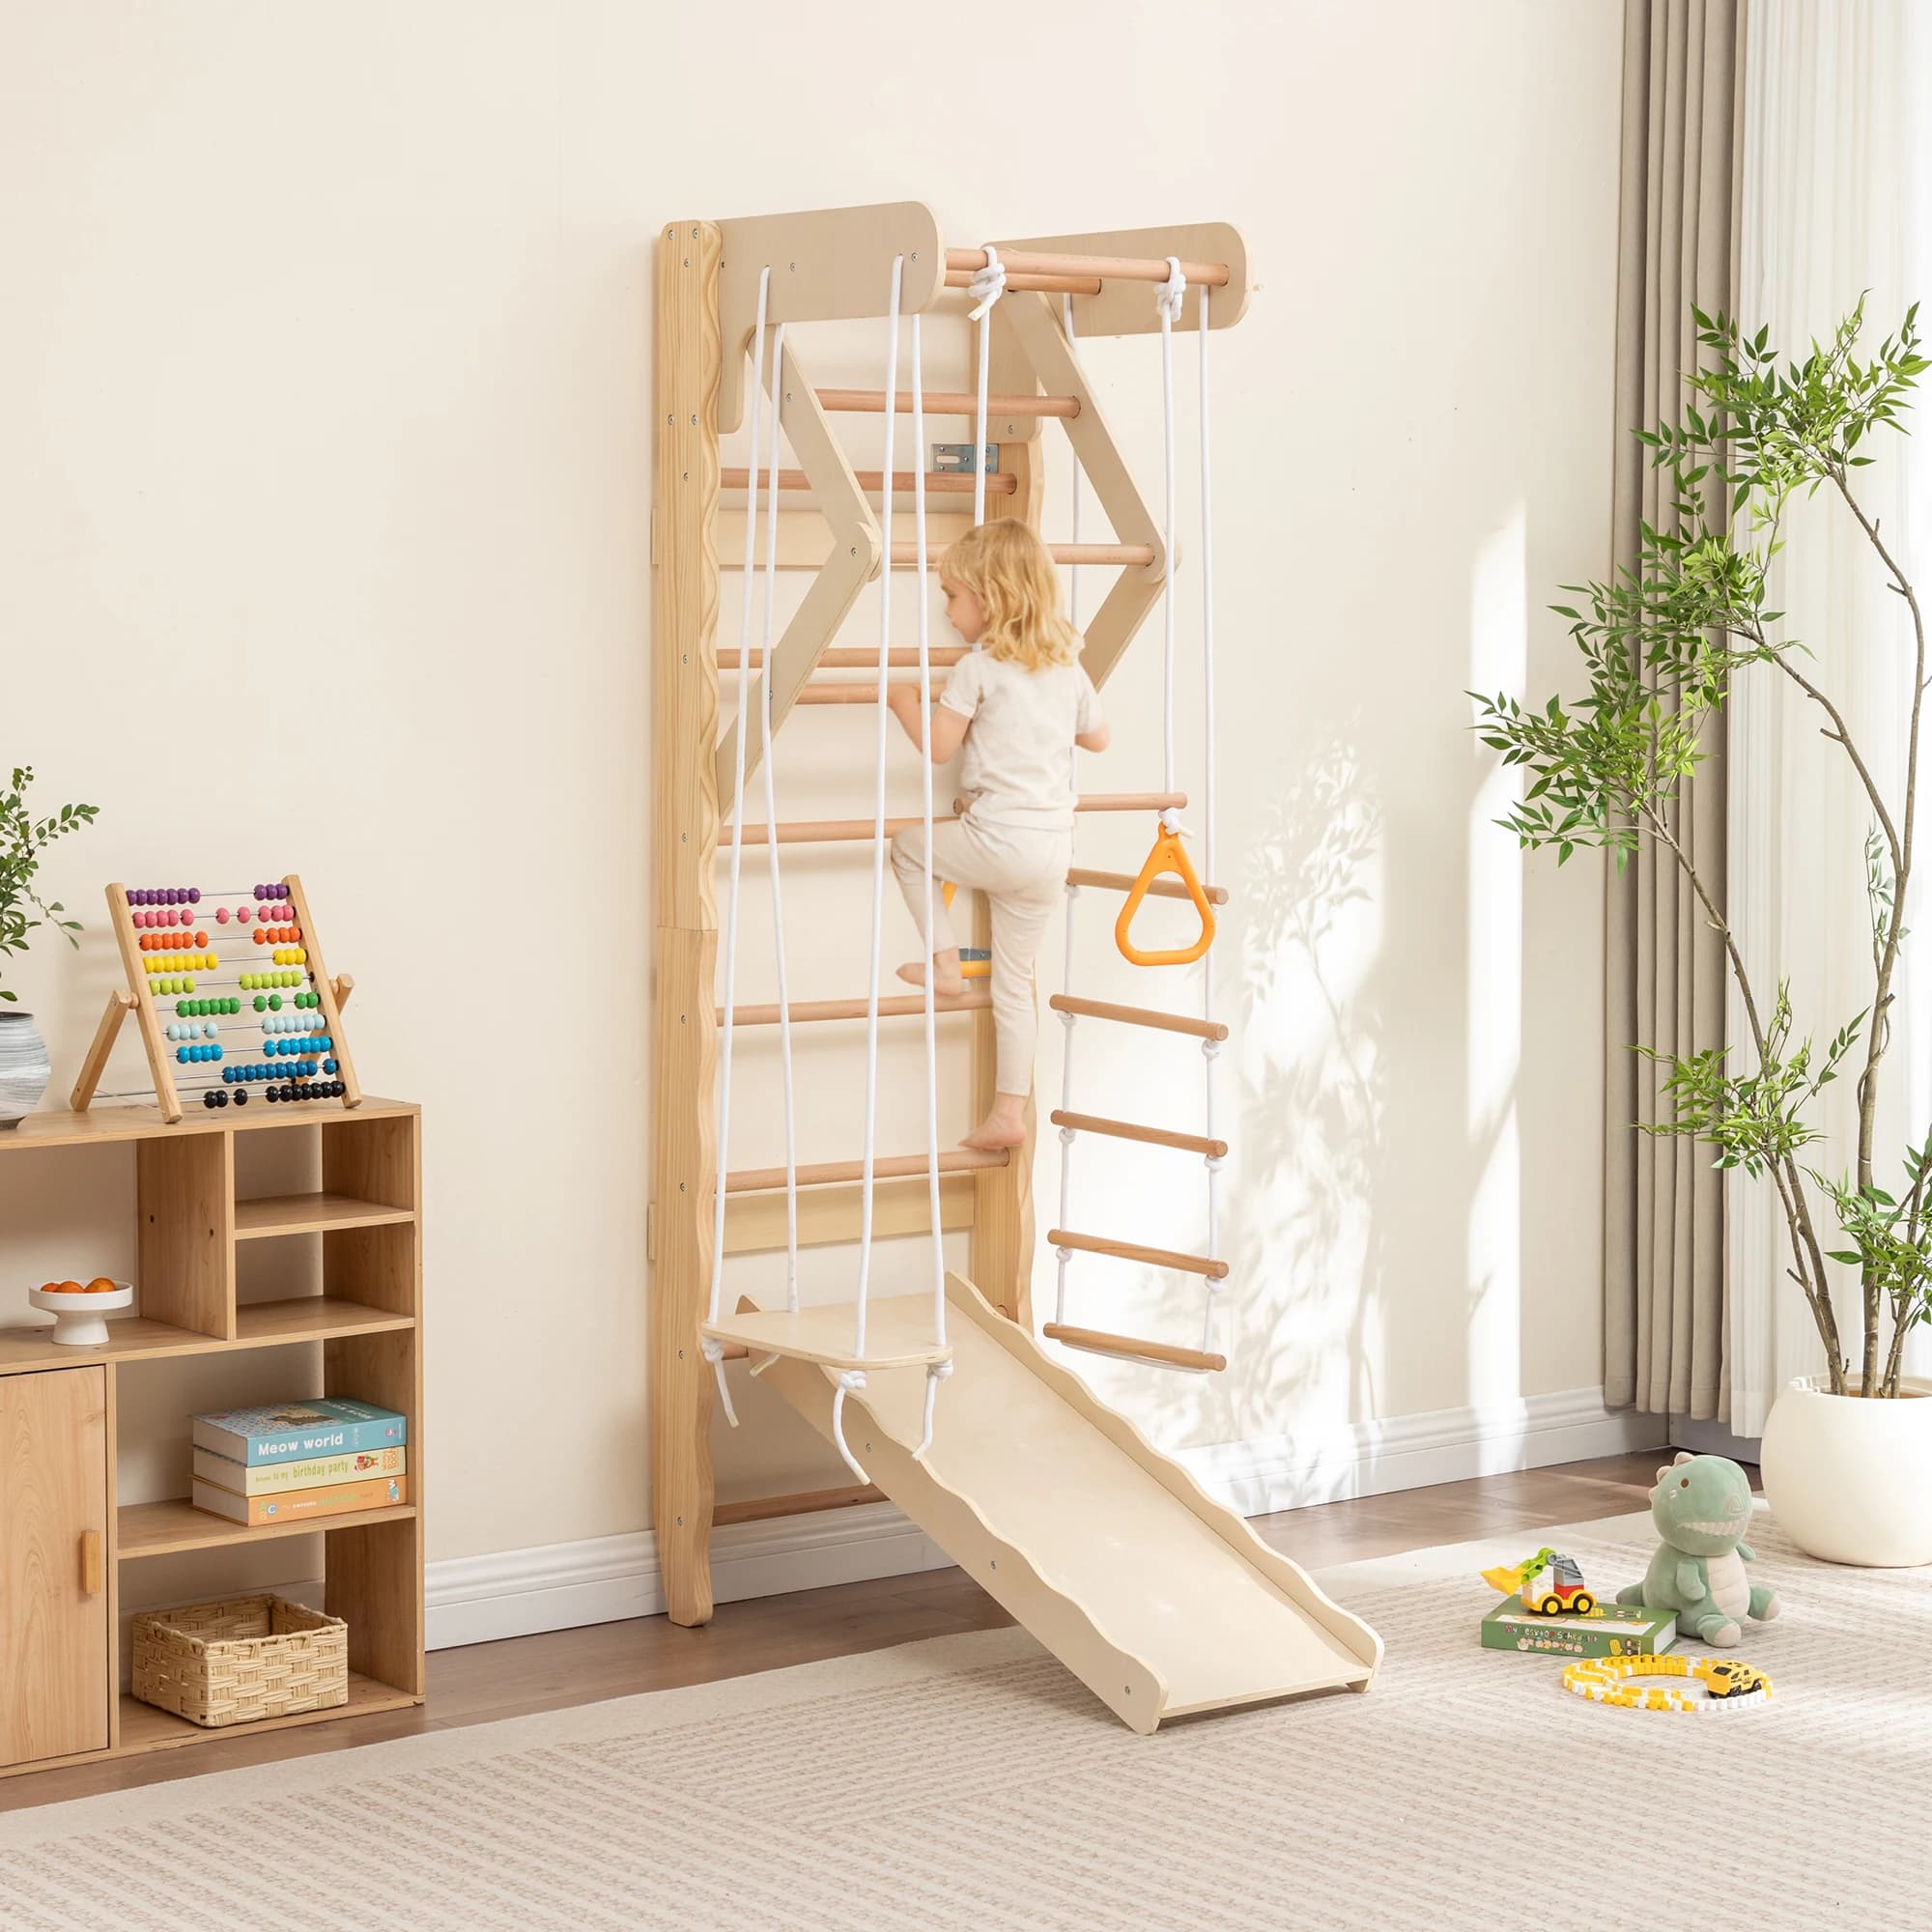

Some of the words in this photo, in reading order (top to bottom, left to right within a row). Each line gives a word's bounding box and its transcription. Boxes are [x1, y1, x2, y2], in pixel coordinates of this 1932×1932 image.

[258, 1440, 298, 1457] Meow
[303, 1433, 344, 1449] world
[293, 1463, 326, 1479] birthday
[328, 1460, 349, 1476] party
